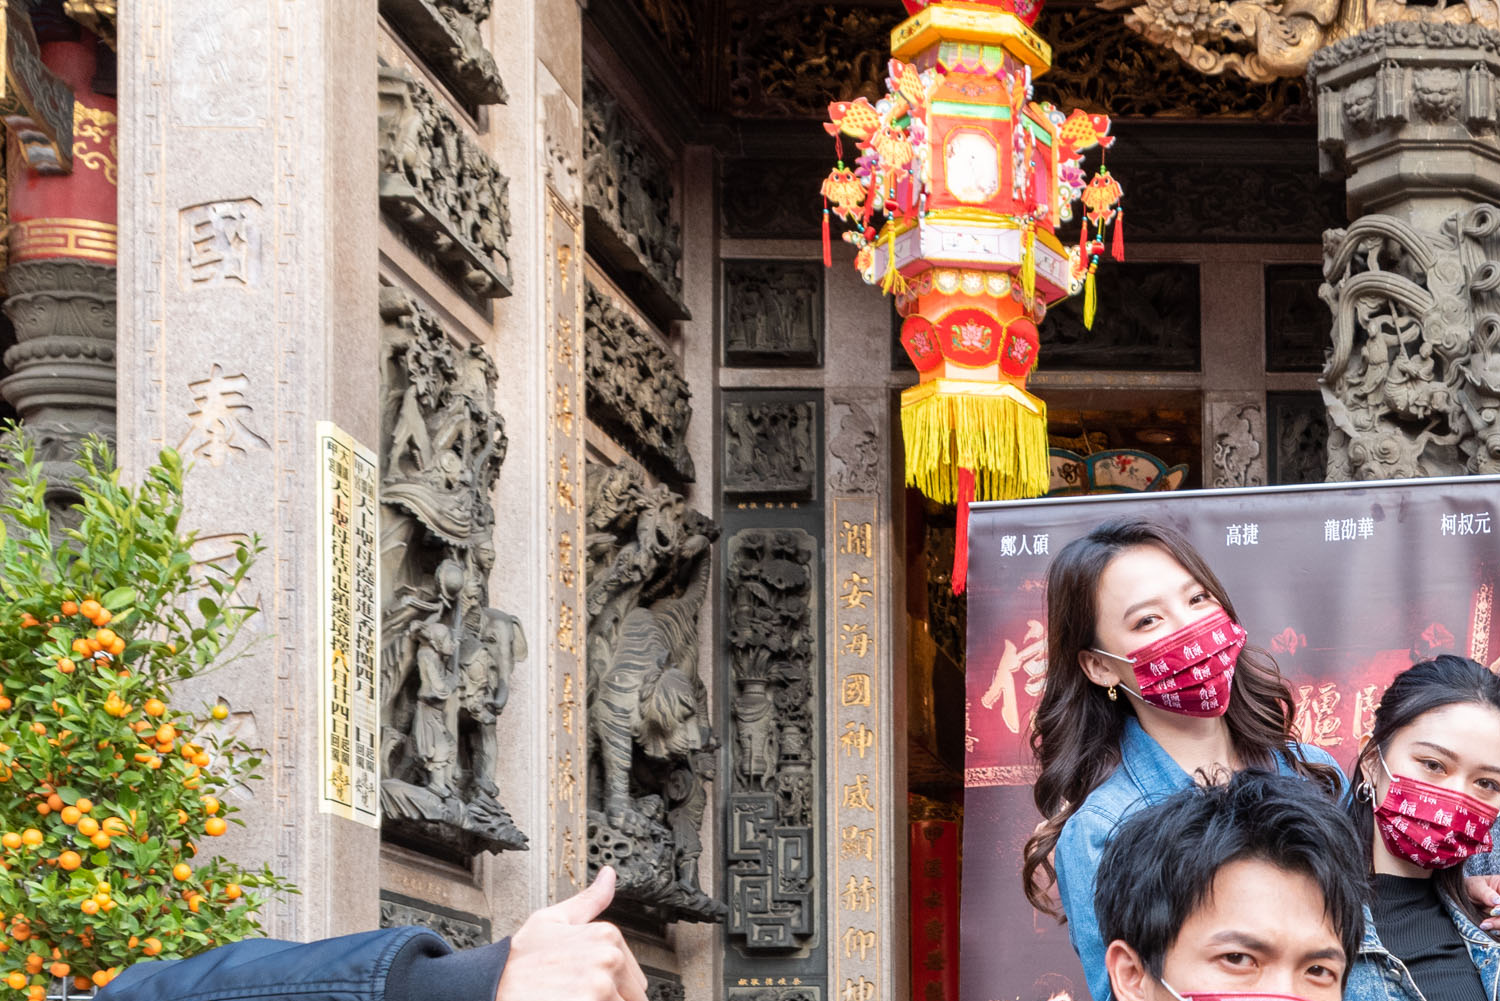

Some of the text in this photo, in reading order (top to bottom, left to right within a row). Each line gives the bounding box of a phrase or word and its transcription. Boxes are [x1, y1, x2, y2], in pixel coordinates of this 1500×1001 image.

[1000, 511, 1491, 557] 鄭人碩 高捷 龍劭華 柯叔元
[1212, 630, 1227, 645] 角頭
[1184, 642, 1203, 660] 角頭
[1150, 659, 1169, 676] 角頭
[1193, 665, 1211, 680] 角頭
[1200, 685, 1216, 699] 角頭
[1399, 799, 1416, 816] 角頭
[1392, 817, 1408, 833] 角頭
[1434, 809, 1453, 827] 角頭
[1464, 820, 1476, 837] 角頭
[1421, 836, 1439, 853] 角頭
